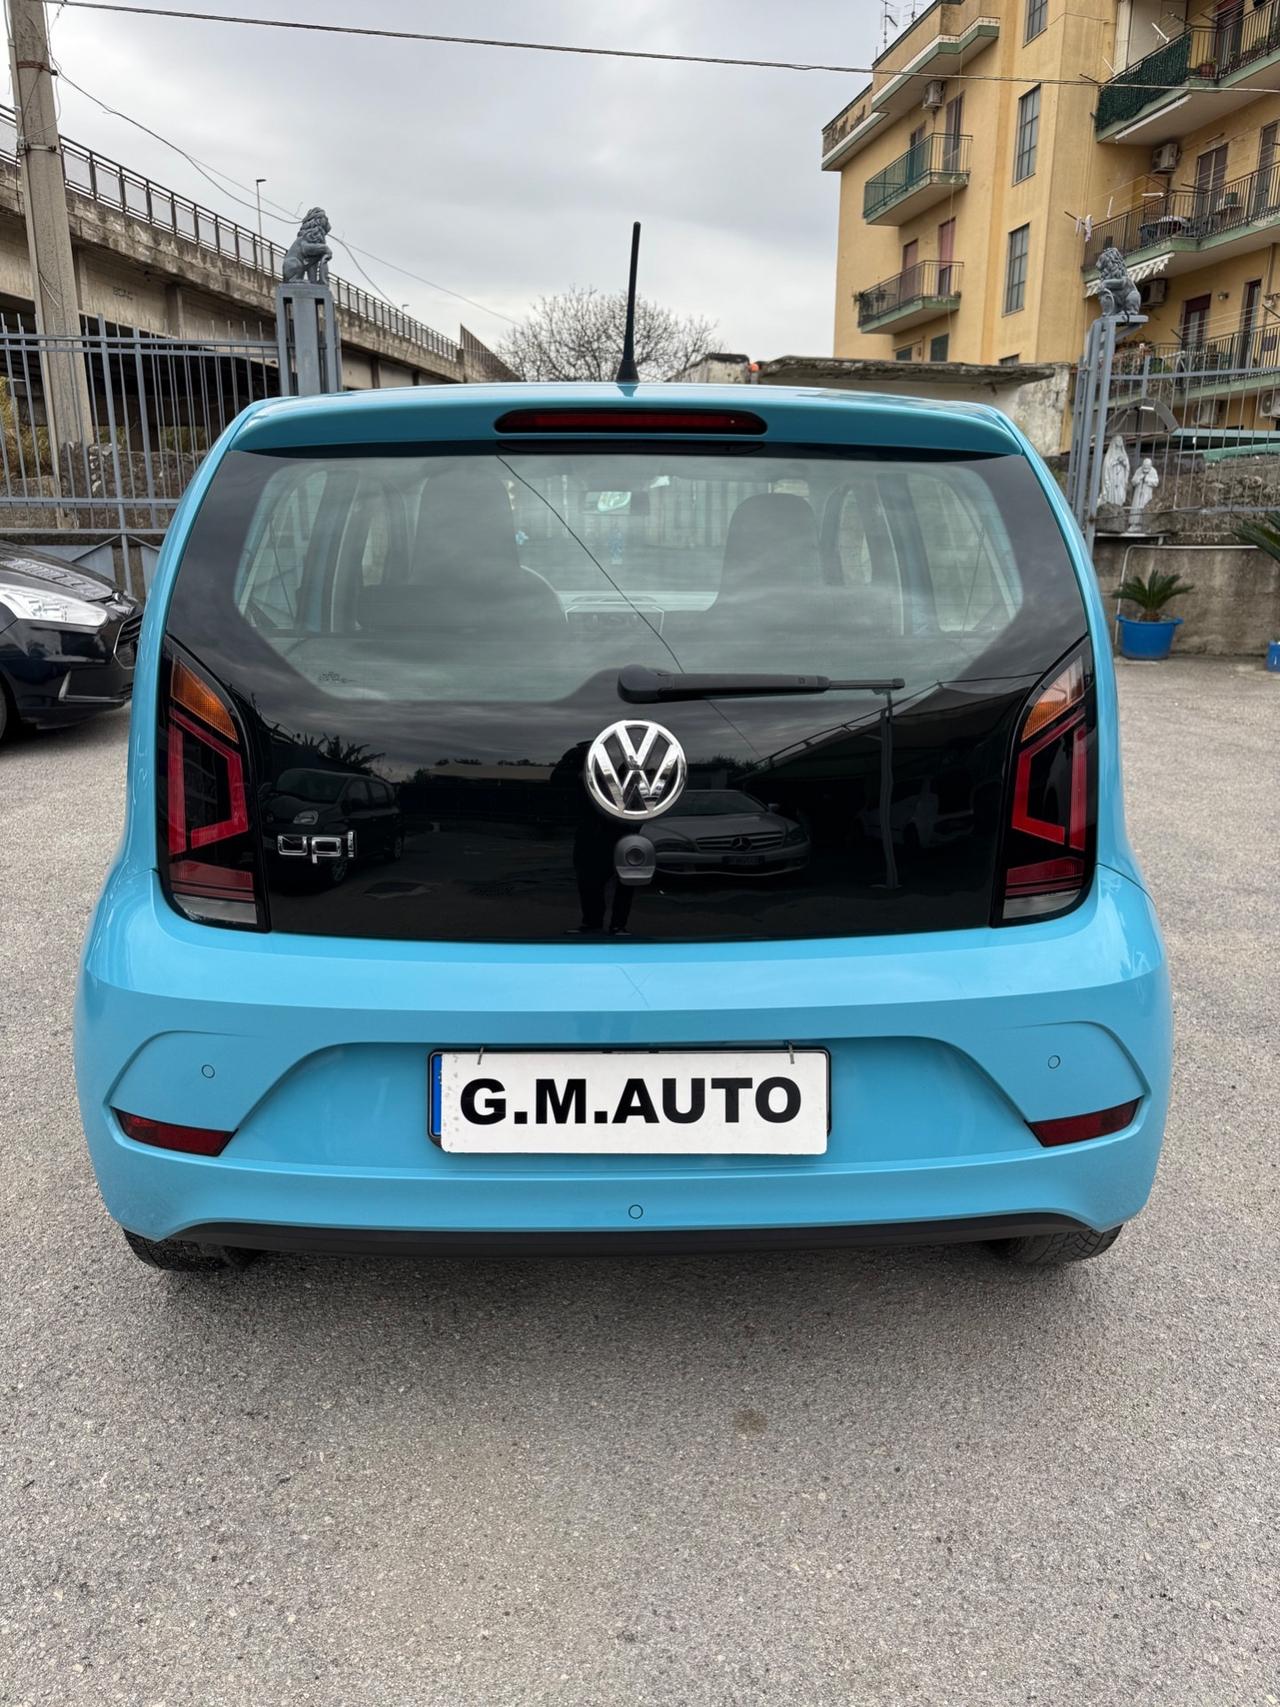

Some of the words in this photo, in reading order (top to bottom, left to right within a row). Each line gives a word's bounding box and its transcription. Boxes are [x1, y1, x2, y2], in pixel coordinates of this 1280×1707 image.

[586, 719, 687, 820] VW
[277, 830, 355, 864] up!
[460, 1076, 801, 1125] G.M.AUTO
